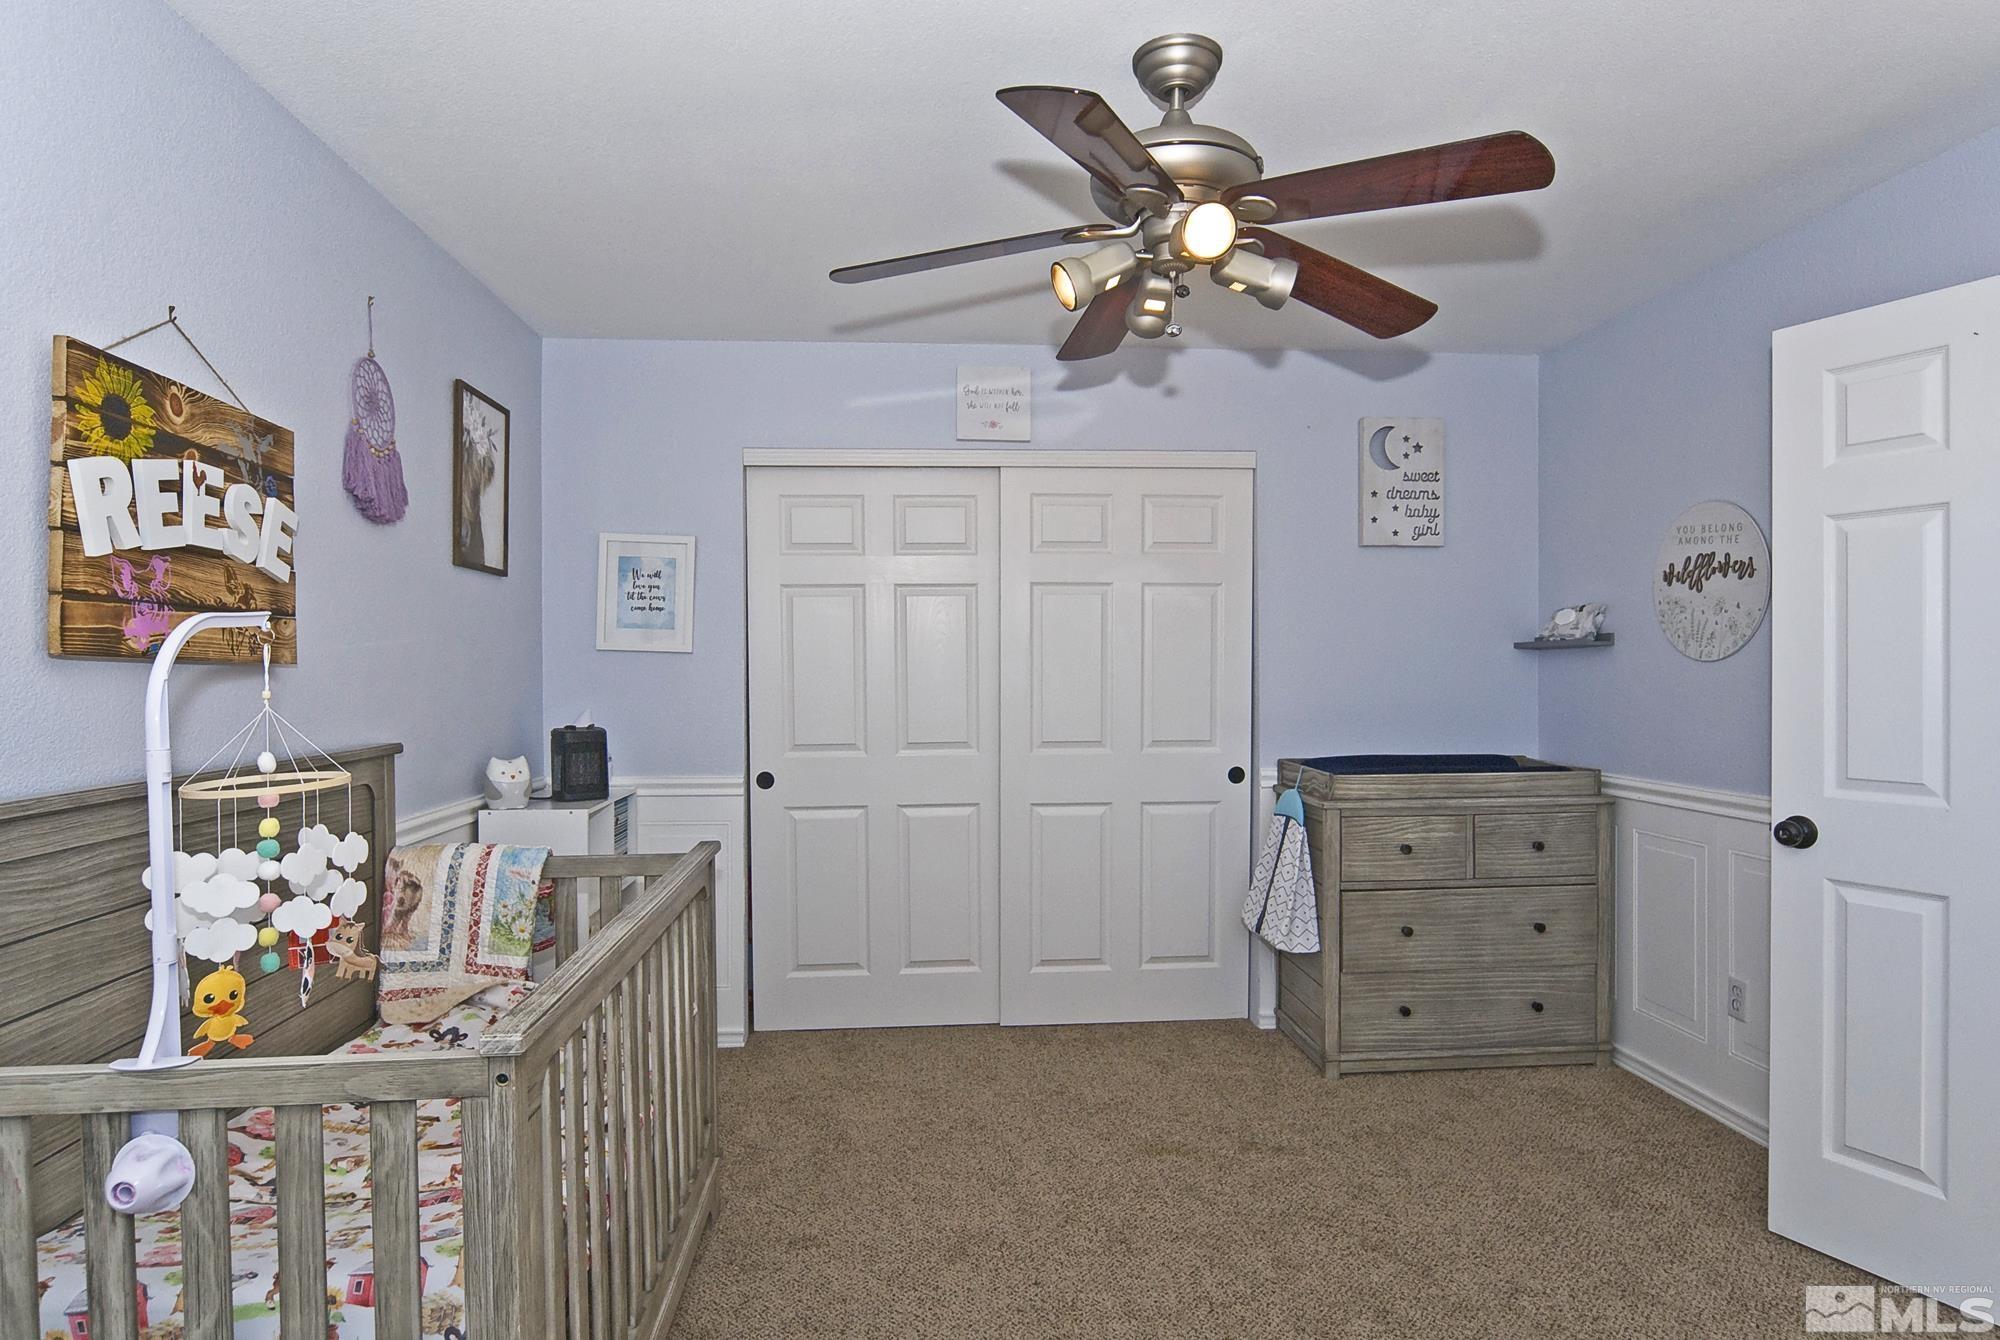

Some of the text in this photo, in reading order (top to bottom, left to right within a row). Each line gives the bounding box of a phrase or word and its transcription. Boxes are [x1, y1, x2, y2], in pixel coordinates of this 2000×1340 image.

[1402, 471, 1440, 482] sweet
[1386, 486, 1440, 500] dreams
[67, 456, 299, 583] REESE
[1404, 504, 1440, 524] baby
[1411, 522, 1440, 541] girl
[1676, 522, 1744, 535] YOU BELONG
[1678, 534, 1741, 545] AMONG THE
